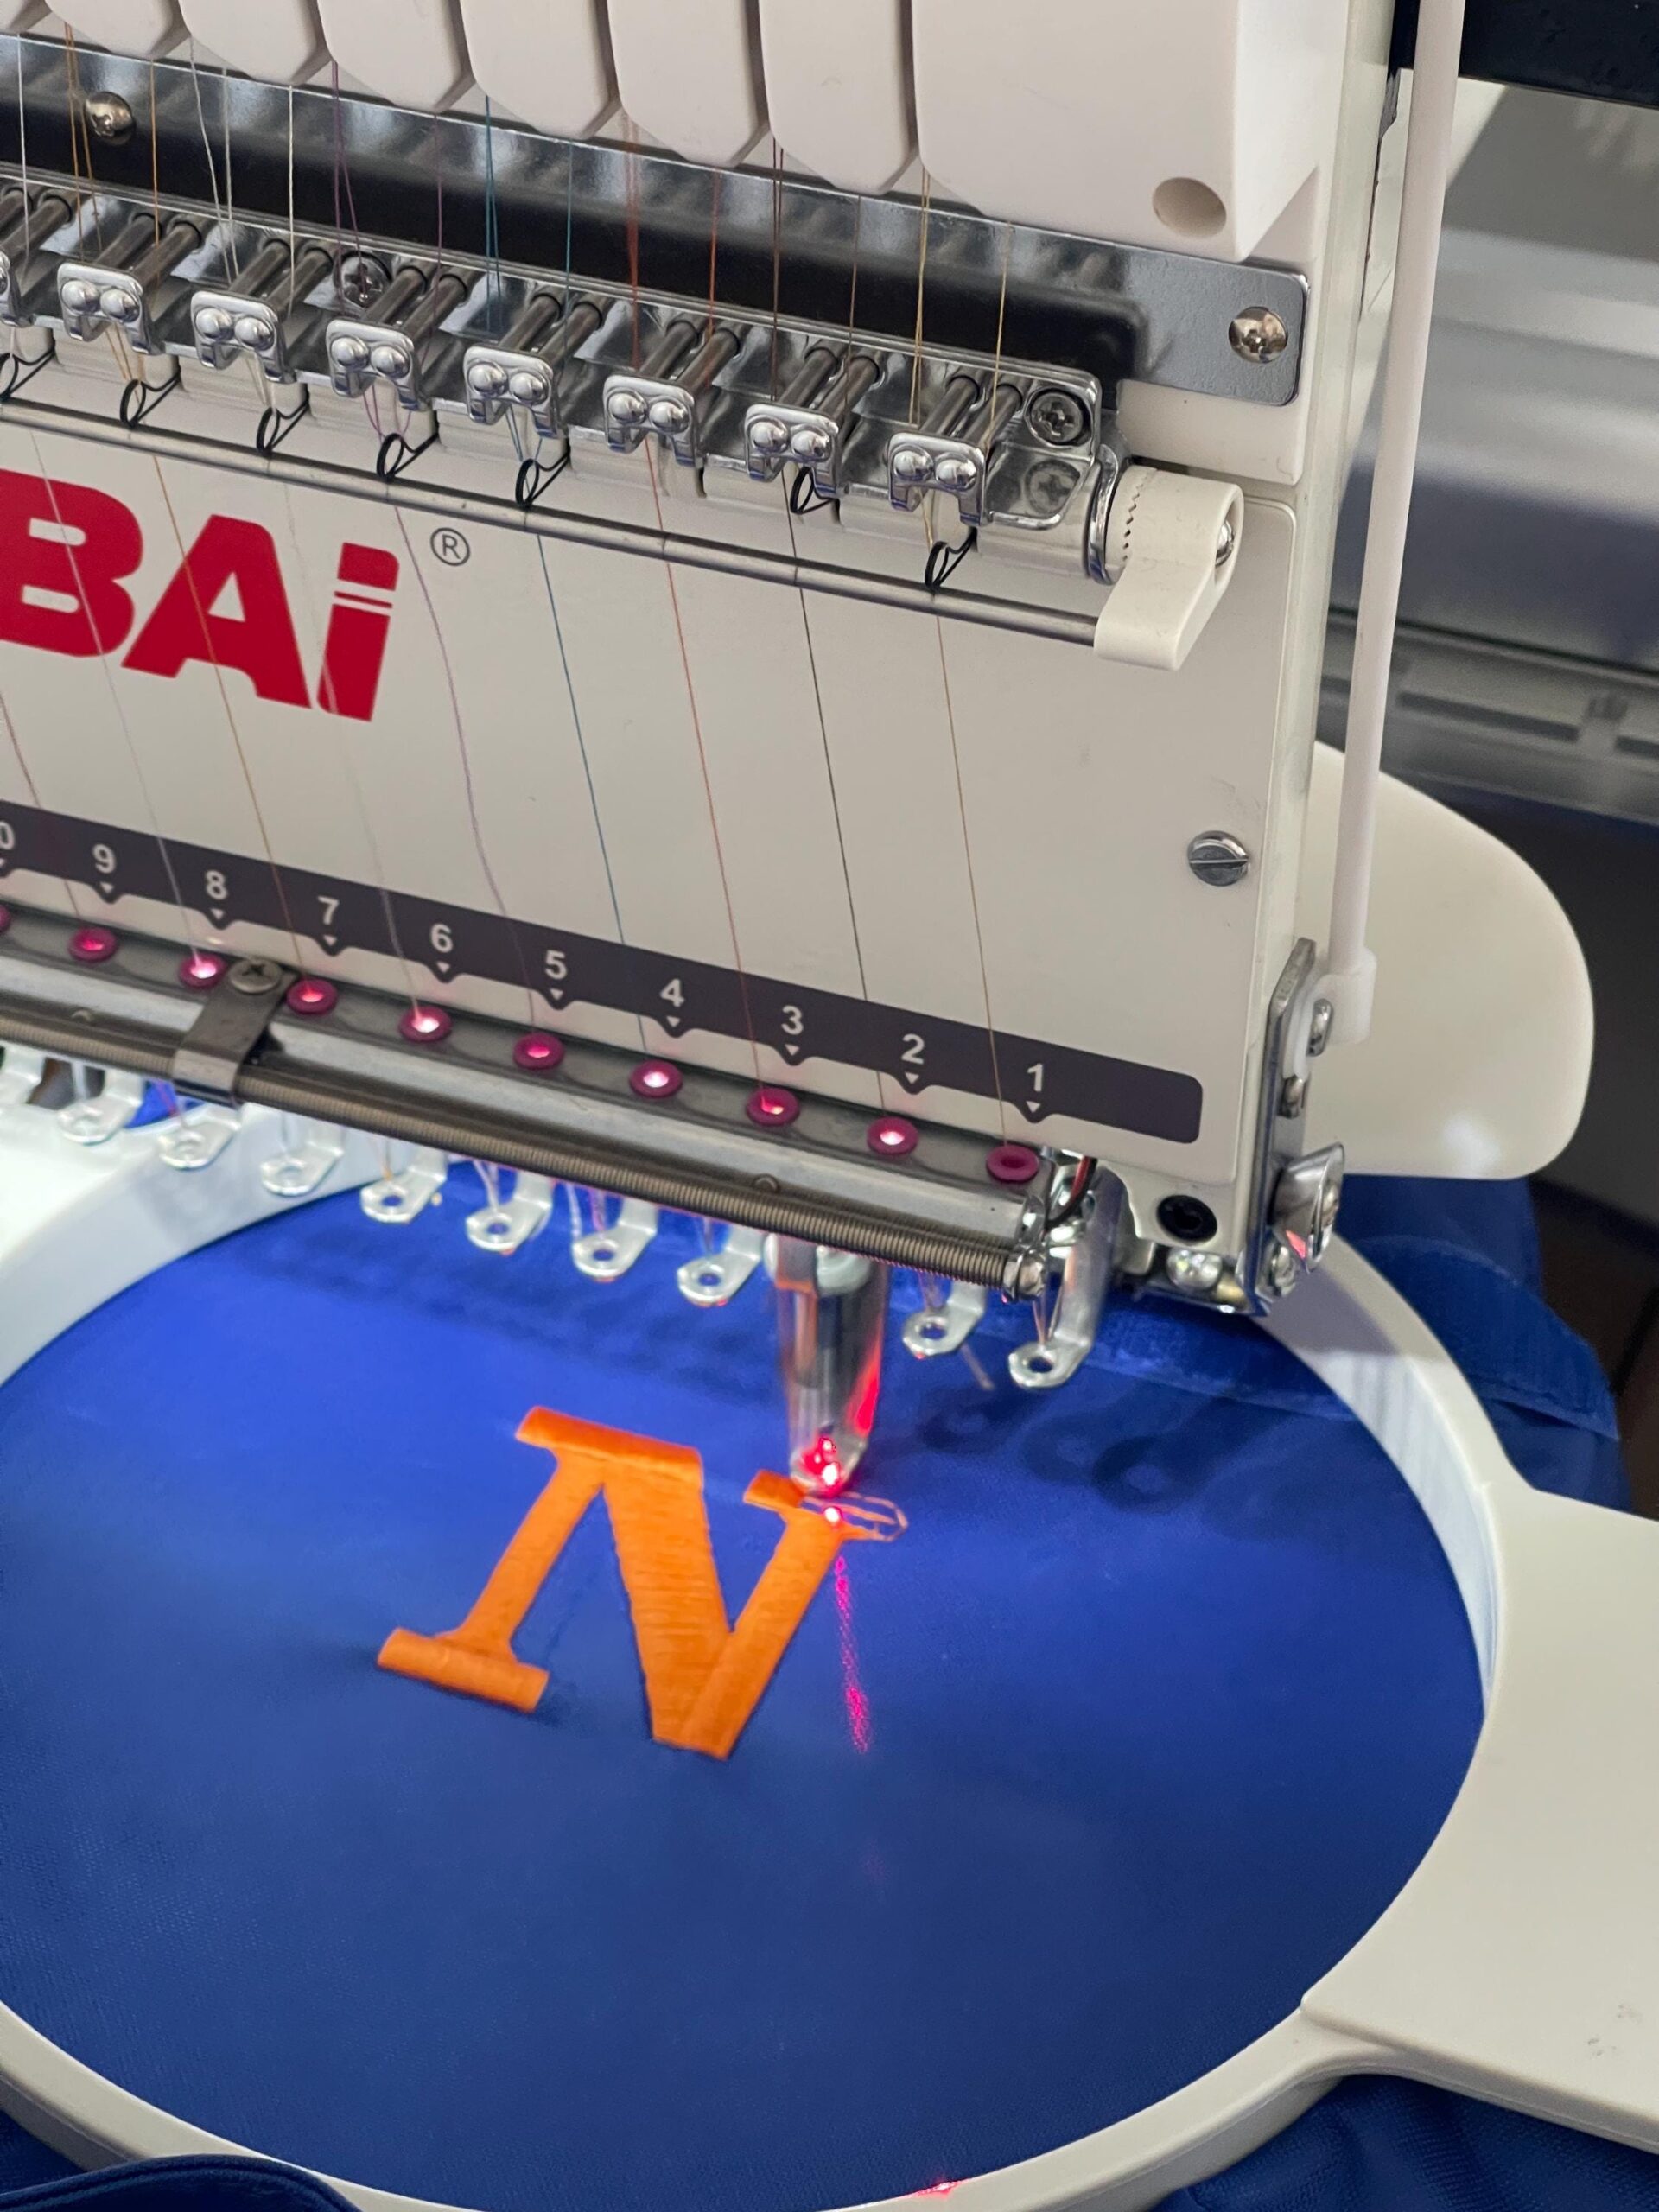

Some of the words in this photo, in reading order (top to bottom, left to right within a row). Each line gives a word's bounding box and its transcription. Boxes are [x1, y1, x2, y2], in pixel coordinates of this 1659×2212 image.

[92, 844, 116, 874] 9
[205, 870, 228, 900] 8
[318, 896, 340, 925] 7
[430, 924, 453, 953] 6
[545, 950, 567, 980] 5
[660, 979, 685, 1007] 4
[781, 1005, 804, 1035] 3
[901, 1033, 925, 1065] 2
[1027, 1063, 1043, 1092] 1
[377, 1405, 907, 1759] N
